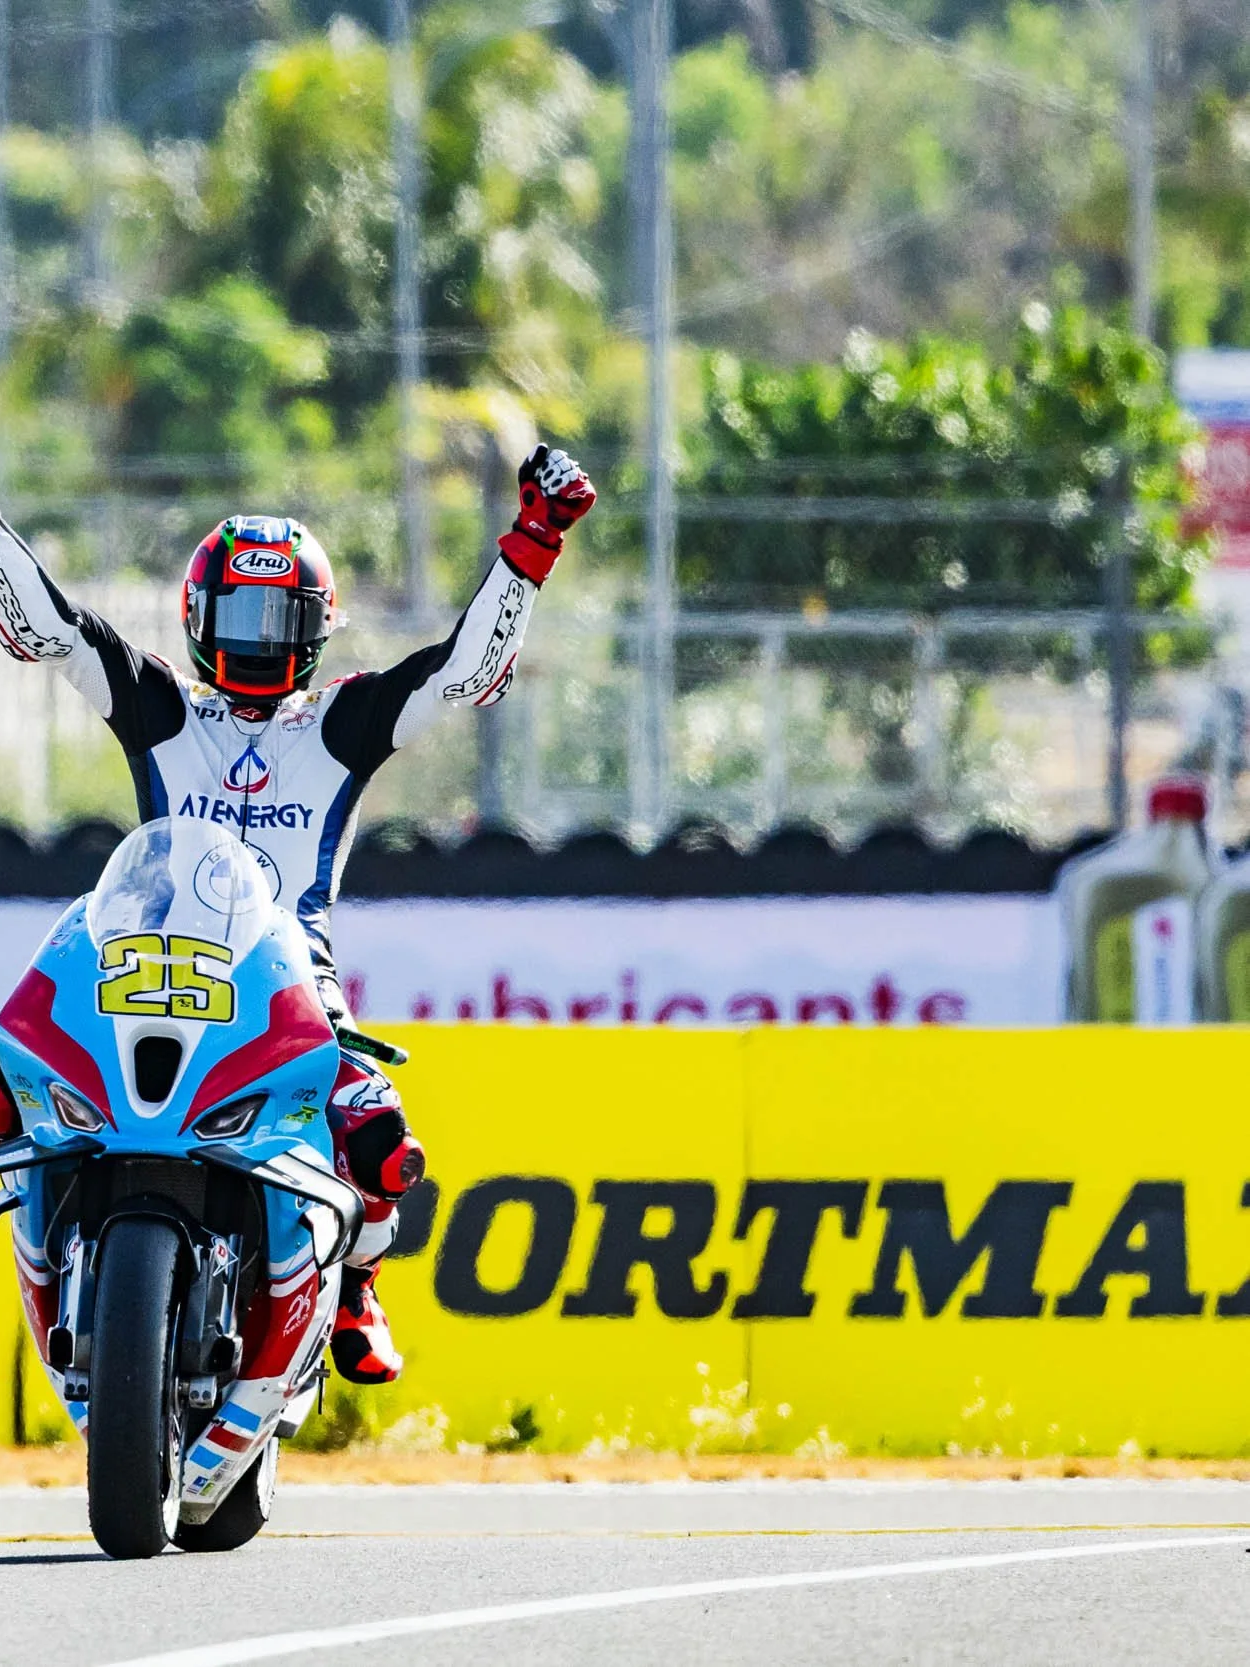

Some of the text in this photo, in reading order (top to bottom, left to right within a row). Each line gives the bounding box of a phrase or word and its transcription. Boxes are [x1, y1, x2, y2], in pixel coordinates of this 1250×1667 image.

[236, 553, 284, 569] Arai
[443, 579, 524, 700] alpinestars
[98, 933, 235, 1022] 25
[384, 1174, 1250, 1321] ORTMA
